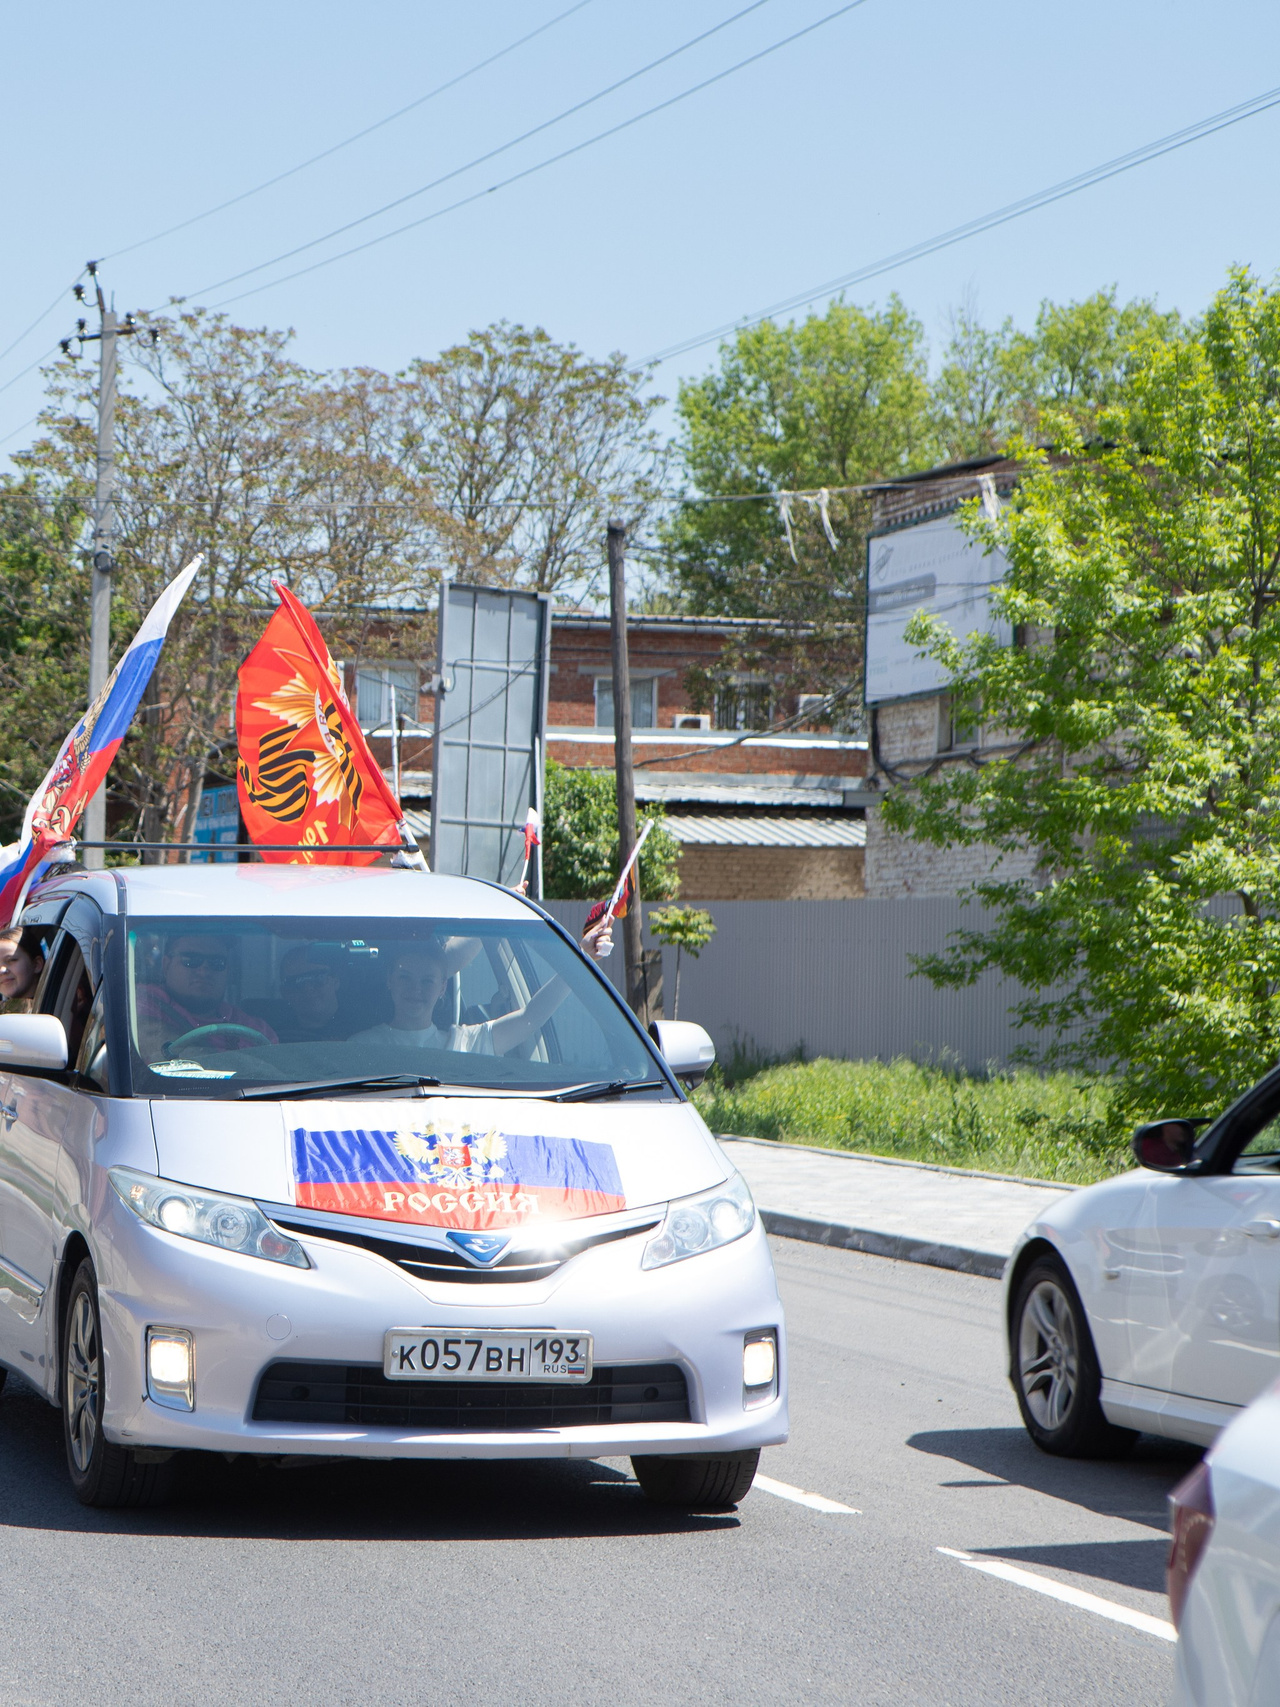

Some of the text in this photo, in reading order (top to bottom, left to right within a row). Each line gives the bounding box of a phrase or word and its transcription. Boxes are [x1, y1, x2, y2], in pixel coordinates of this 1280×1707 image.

[383, 1191, 541, 1215] РОССИЯ
[399, 1338, 580, 1372] К057ВН 193
[543, 1364, 567, 1374] RUS
